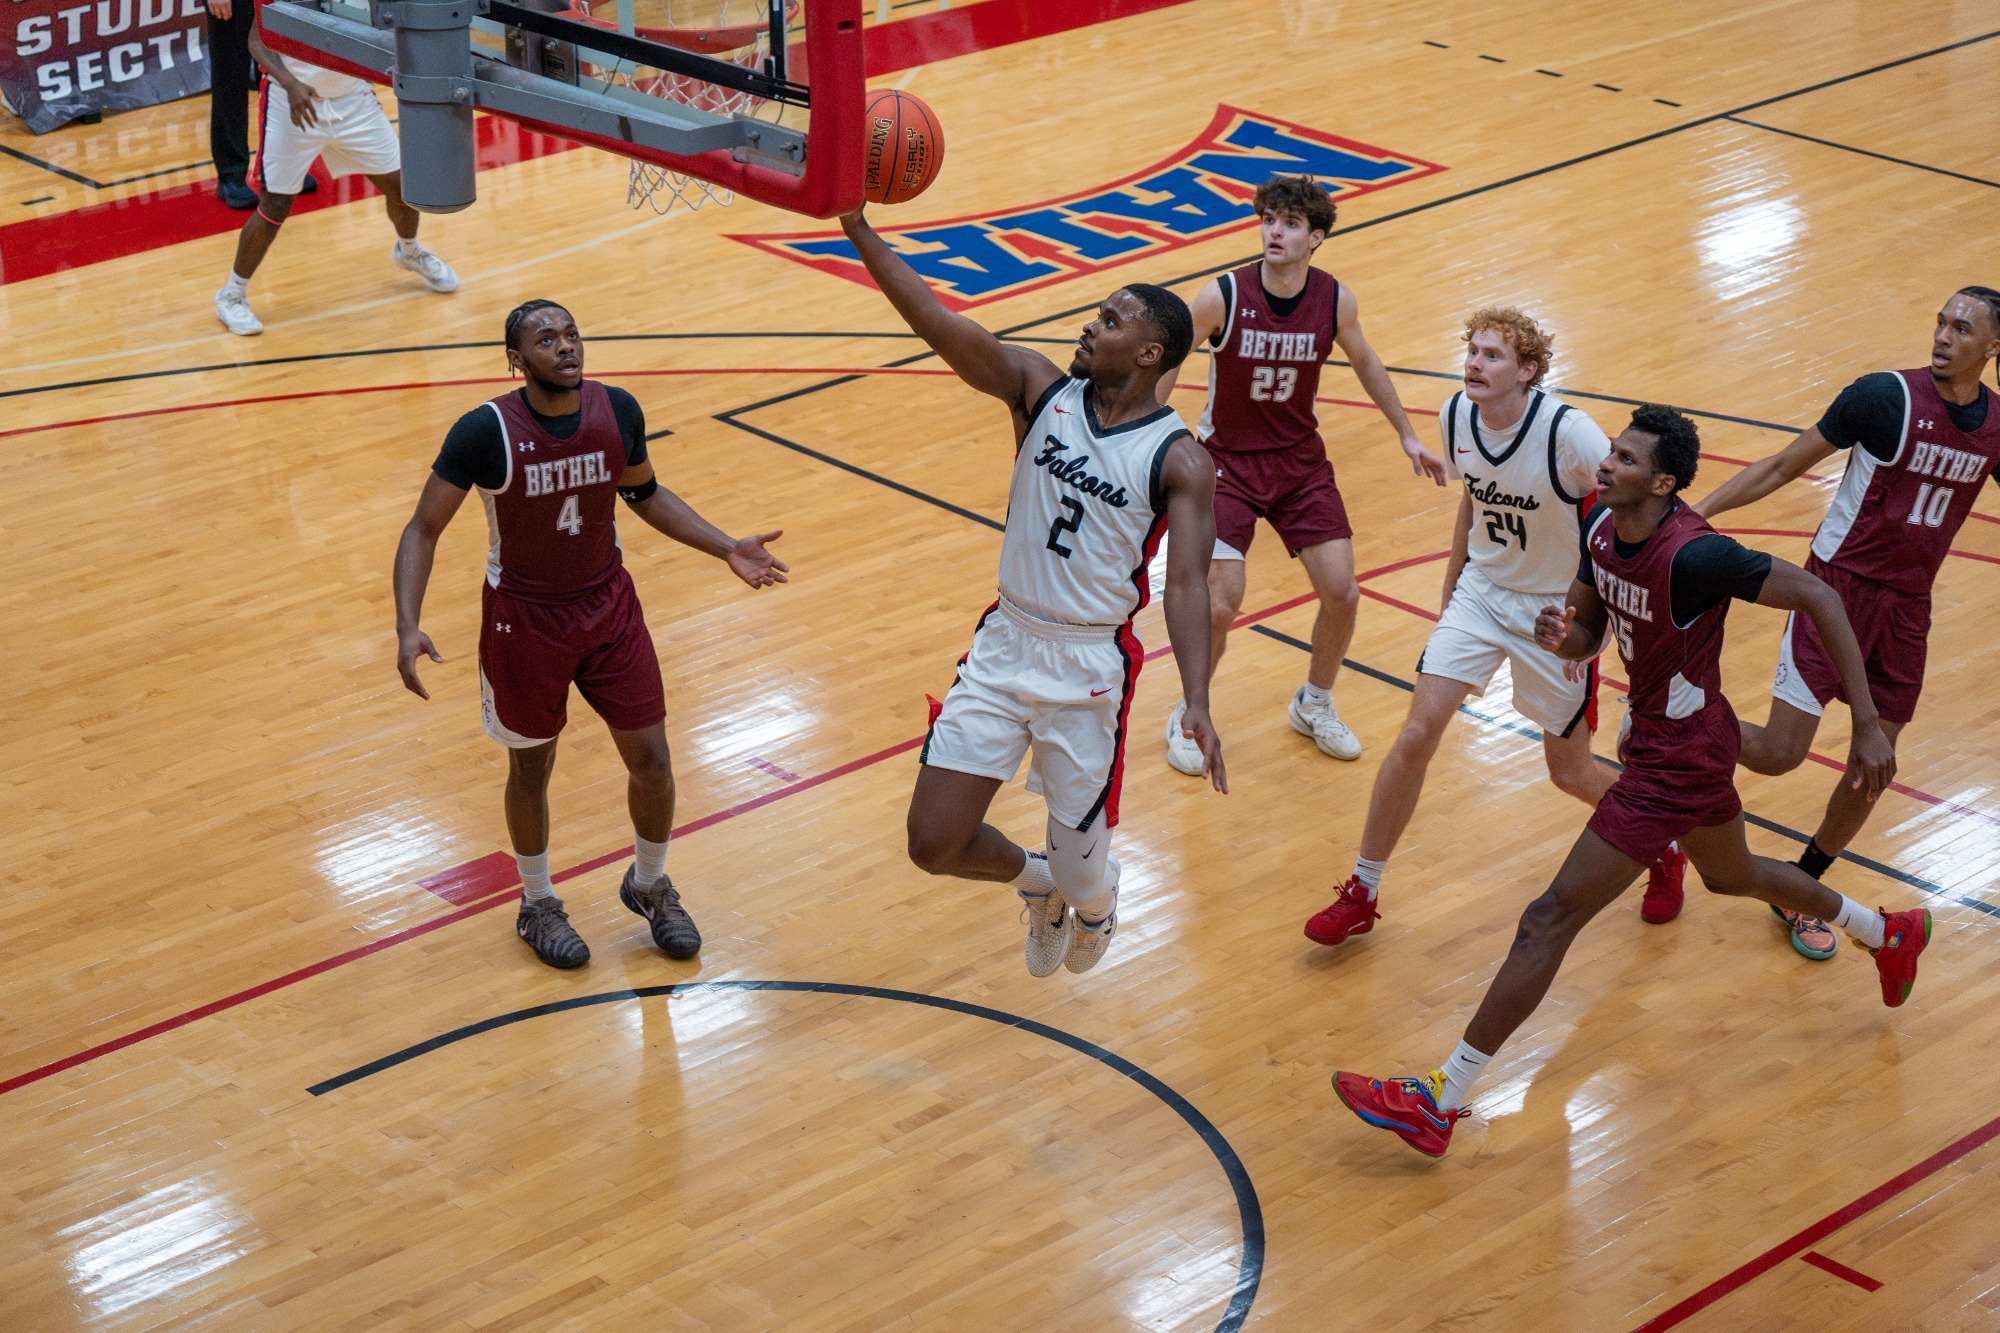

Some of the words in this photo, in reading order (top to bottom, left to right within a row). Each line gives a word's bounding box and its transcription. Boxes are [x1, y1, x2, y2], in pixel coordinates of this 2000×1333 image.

[865, 116, 894, 193] SPALDING
[898, 127, 917, 191] LEGACY
[785, 118, 1413, 296] NAIA
[1238, 328, 1319, 361] BETHEL
[1250, 366, 1299, 402] 23
[524, 450, 611, 497] BETHEL
[1034, 434, 1129, 508] Falcons
[1907, 441, 1988, 483] BETHEL
[1464, 472, 1540, 511] Falcons
[1907, 483, 1954, 528] 10
[556, 494, 583, 536] 4
[1046, 494, 1085, 559] 2
[1483, 509, 1527, 552] 24
